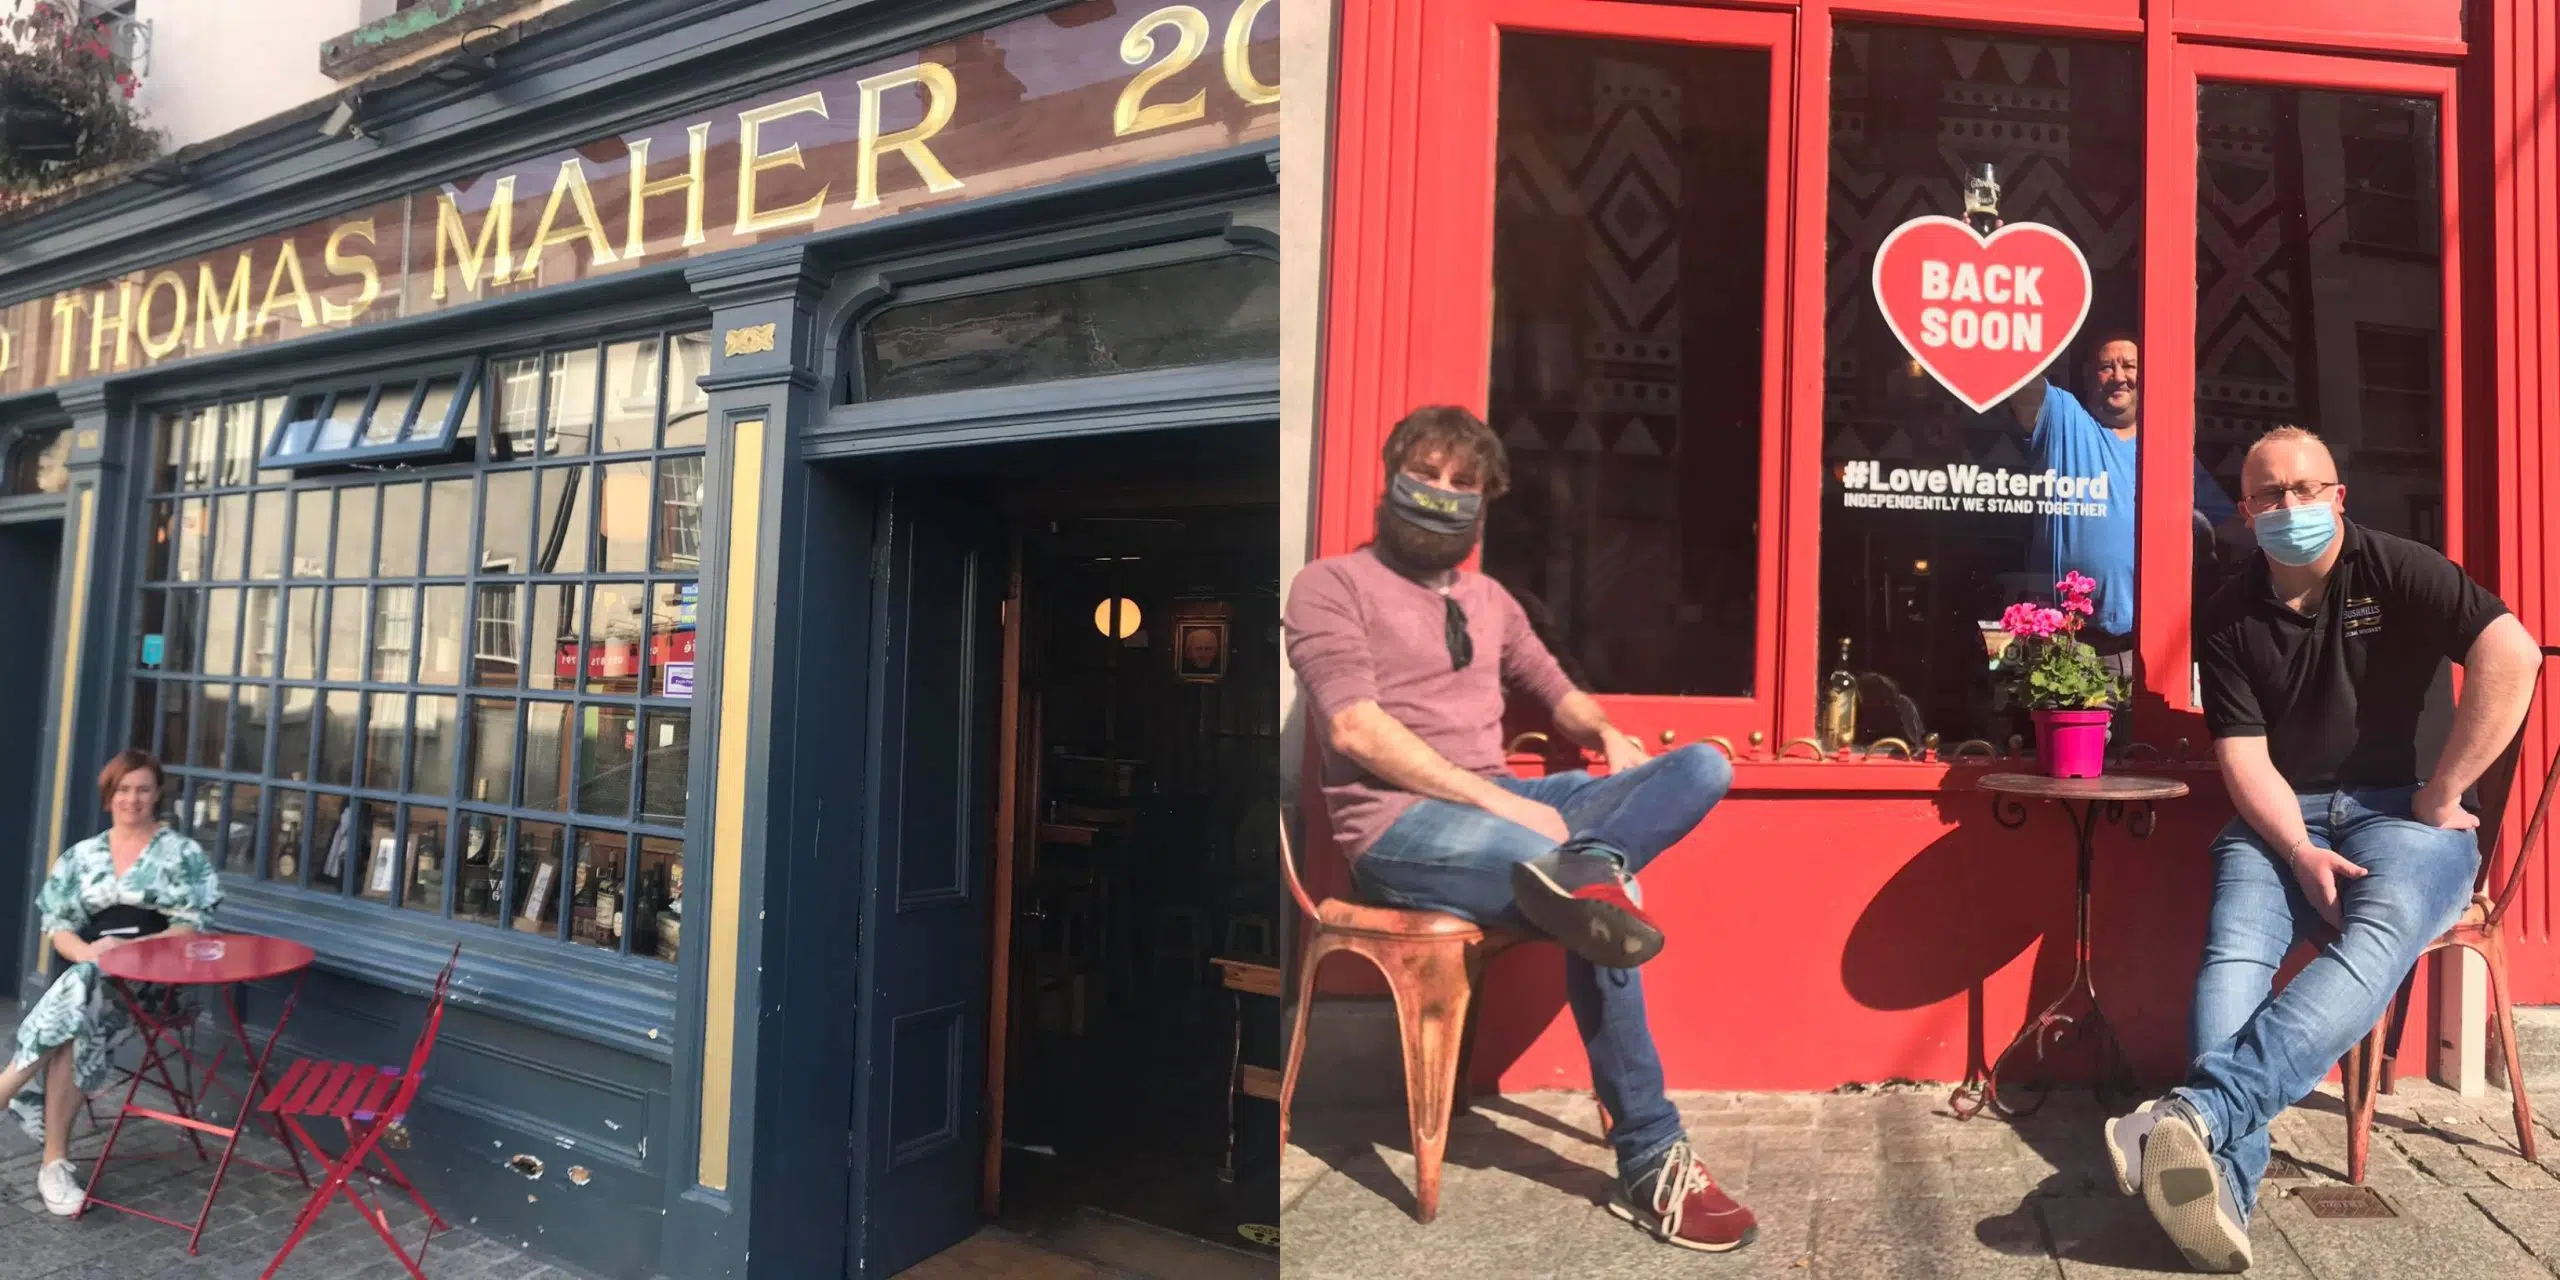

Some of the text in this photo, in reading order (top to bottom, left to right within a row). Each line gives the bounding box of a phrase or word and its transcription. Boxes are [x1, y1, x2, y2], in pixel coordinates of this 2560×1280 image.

[52, 218, 382, 377] THOMAS
[430, 62, 965, 300] MAHER
[1921, 260, 2044, 305] BACK
[1920, 308, 2043, 352] SOON
[1842, 460, 2109, 499] #LoveWaterford
[1844, 492, 2107, 518] INDEPENDENTLY WE STAND TOGETHER
